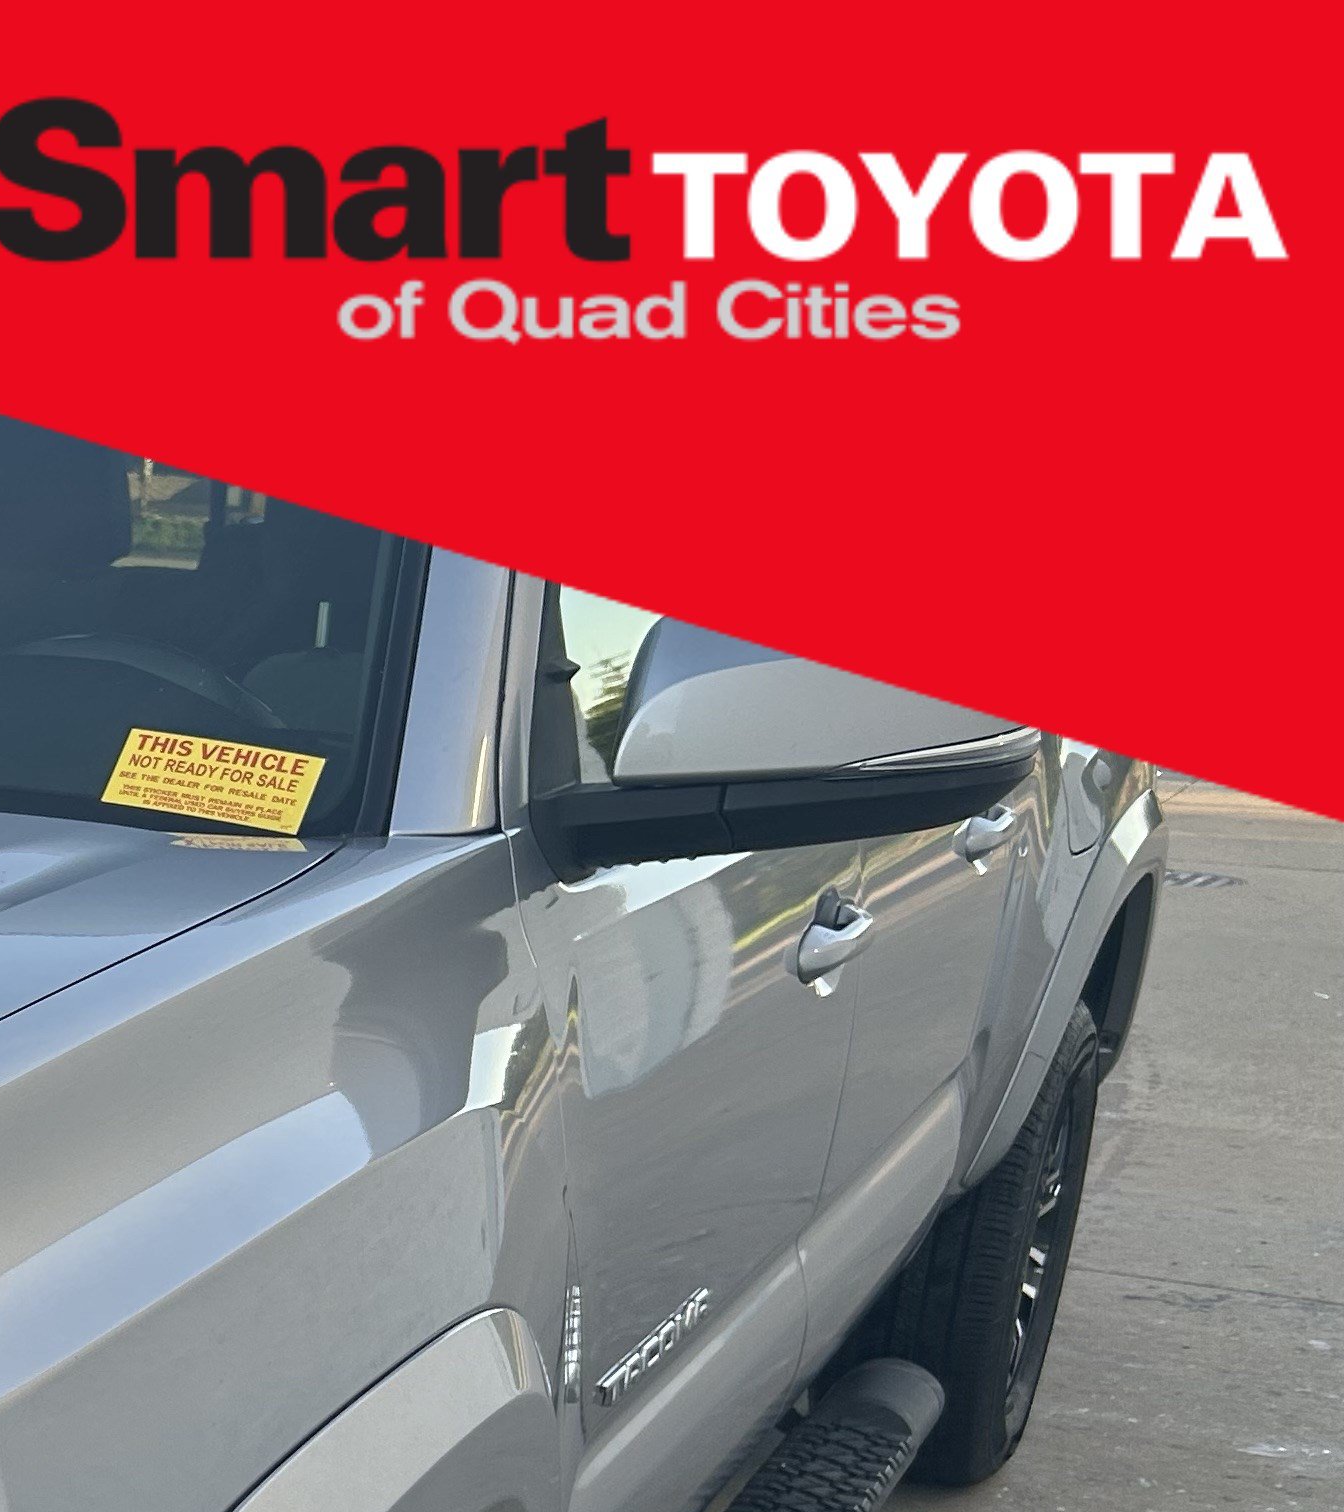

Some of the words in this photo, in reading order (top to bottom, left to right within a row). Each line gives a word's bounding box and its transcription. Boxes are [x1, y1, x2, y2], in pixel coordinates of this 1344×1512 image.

[128, 754, 163, 769] NOT
[164, 759, 219, 778] READY
[220, 767, 254, 785] FOR
[256, 774, 300, 792] SALE
[138, 734, 194, 757] THIS
[202, 743, 309, 776] VEHICLE
[119, 771, 137, 779] SEE
[141, 774, 160, 783] THE
[163, 777, 201, 789] DEALER
[204, 784, 224, 792] FOR
[228, 787, 267, 800] RESALE
[272, 795, 297, 806] DATE
